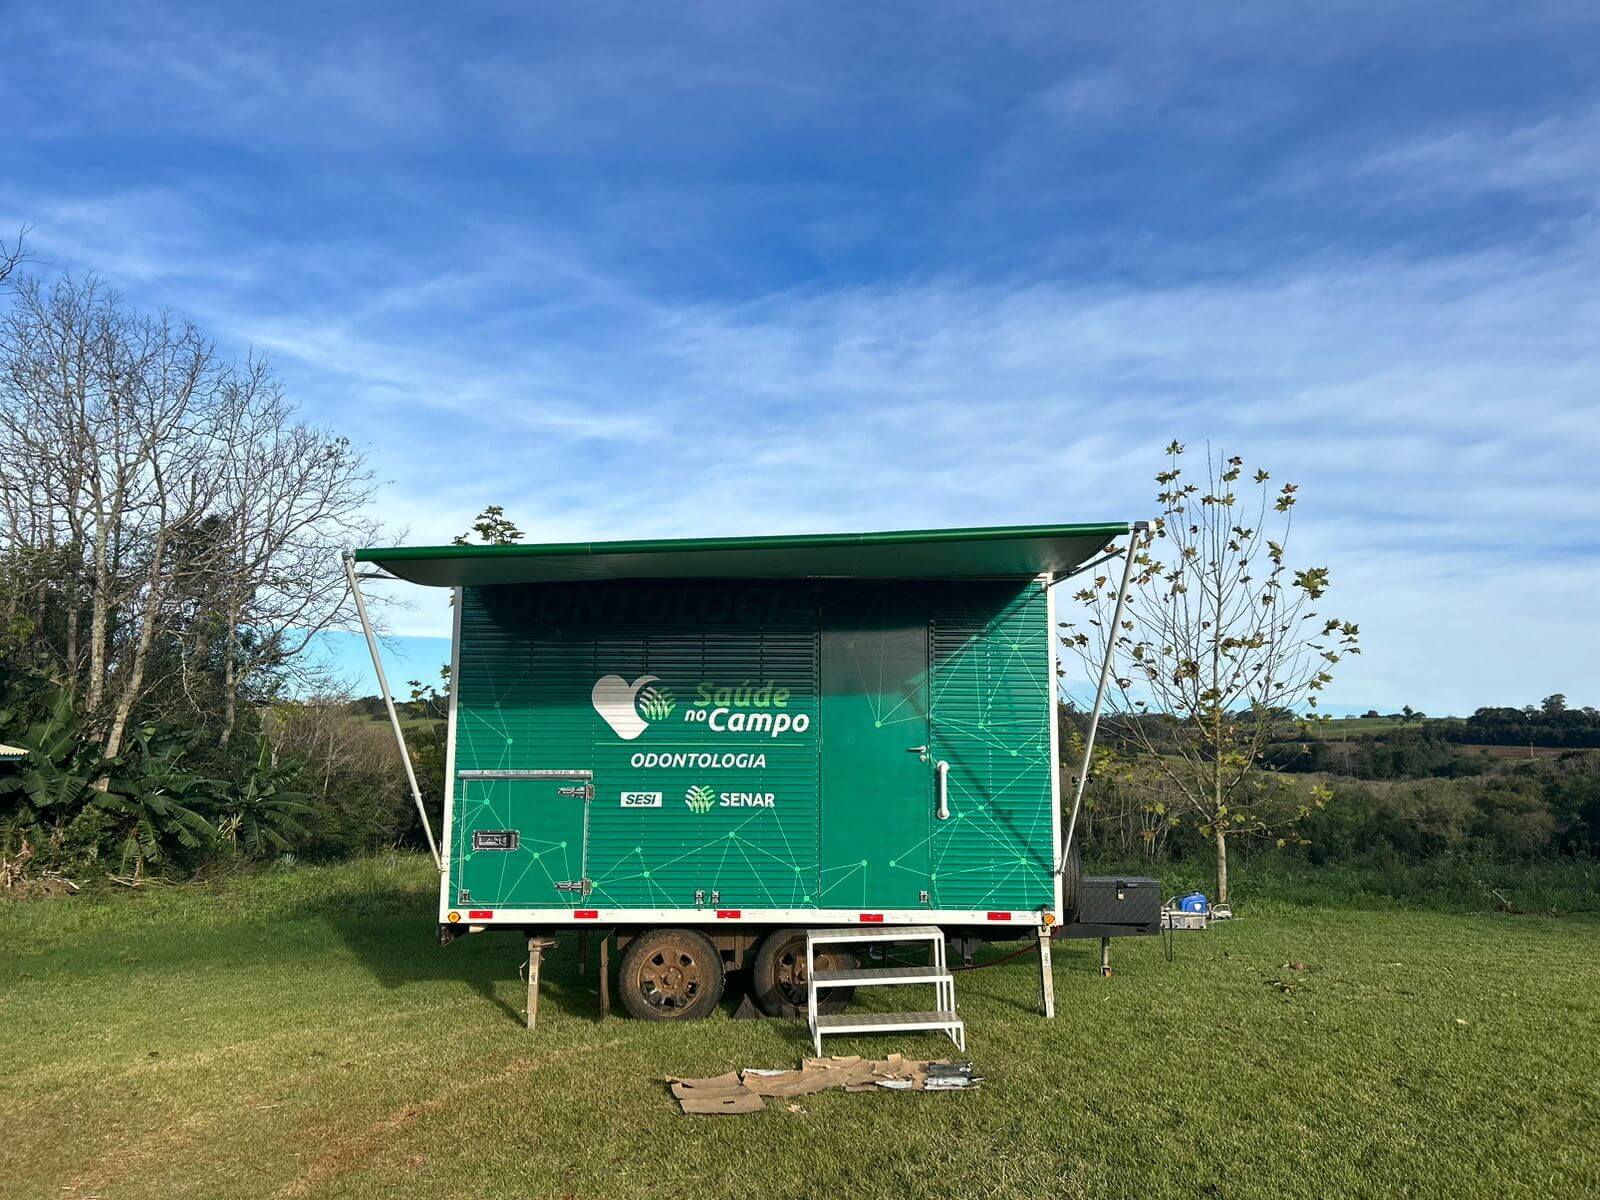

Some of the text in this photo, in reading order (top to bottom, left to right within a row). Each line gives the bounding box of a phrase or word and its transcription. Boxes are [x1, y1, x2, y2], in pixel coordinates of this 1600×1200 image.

[693, 680, 791, 708] Saúde
[684, 708, 810, 738] no Campo
[630, 753, 766, 768] ODONTOLOGIA
[625, 792, 776, 807] SESI SENAR
